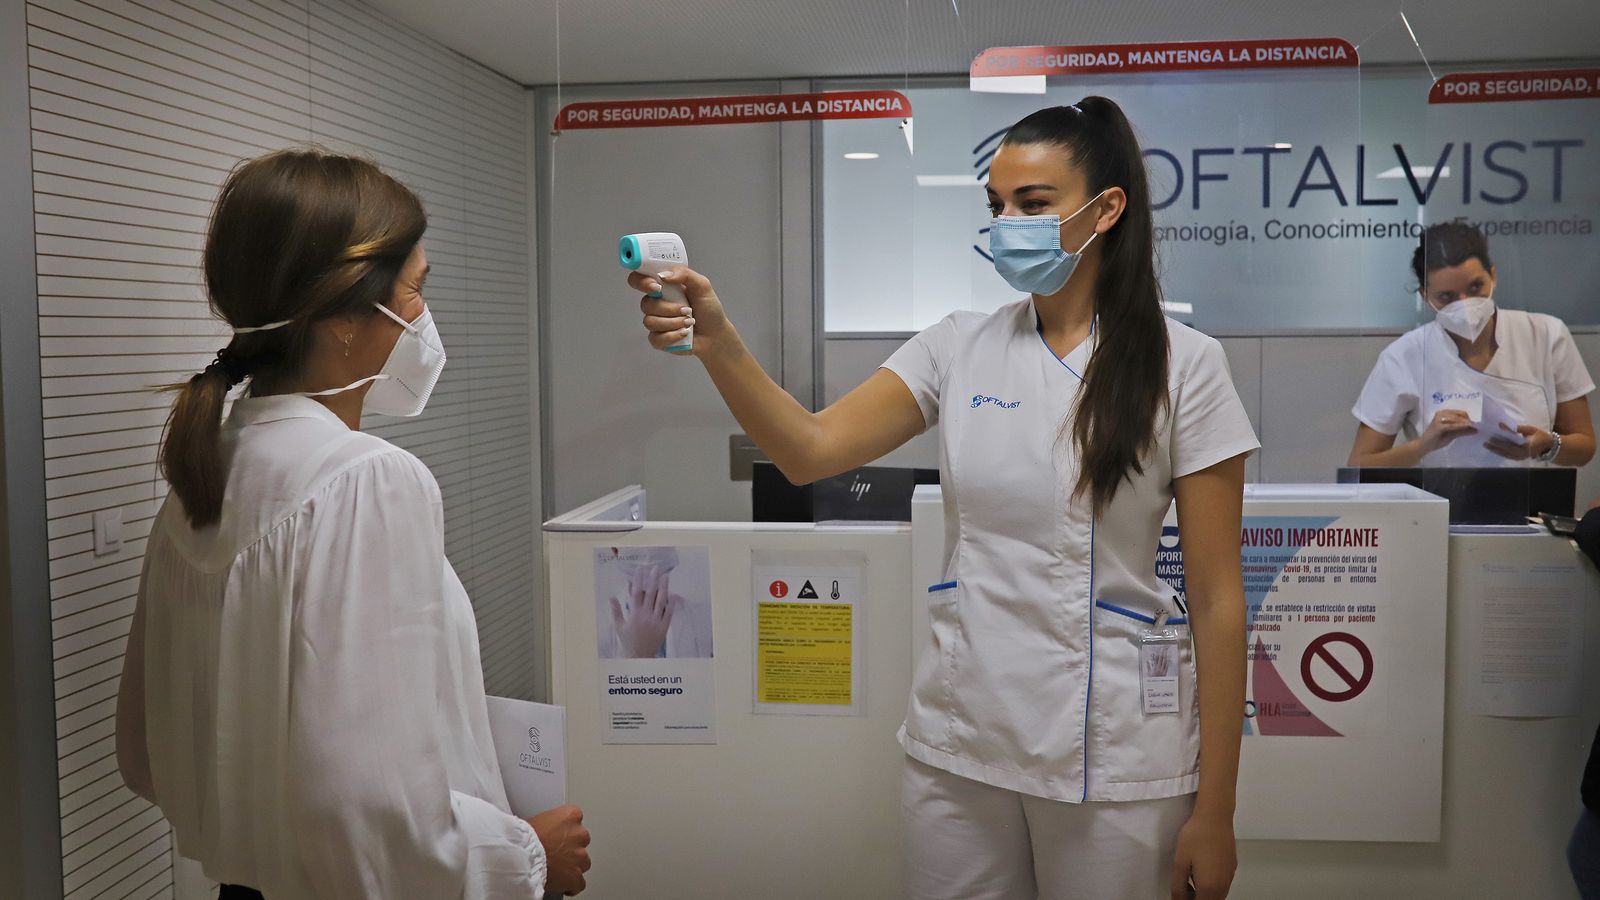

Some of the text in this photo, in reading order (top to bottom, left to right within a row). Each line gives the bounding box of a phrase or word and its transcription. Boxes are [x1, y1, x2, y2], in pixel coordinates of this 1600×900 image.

[1023, 52, 1124, 69] SEGURIDAD,
[1128, 49, 1224, 65] MANTENGA
[1228, 48, 1251, 62] LA
[1255, 46, 1347, 61] DISTANCIA
[1444, 77, 1592, 96] POR SEGURIDAD,
[568, 97, 903, 122] POR SEGURIDAD, MANTENGA LA DISTANCIA
[1264, 218, 1425, 240] Conocimiento
[982, 396, 1021, 409] OFTALVIST
[1241, 528, 1379, 547] AVISO IMPORTANTE
[1301, 555, 1306, 563] la
[1307, 555, 1340, 564] prevención
[1341, 555, 1351, 563] del
[1351, 555, 1367, 563] virus
[1367, 555, 1377, 563] del
[1283, 564, 1312, 574] Covid-19,
[1323, 565, 1345, 574] preciso
[1348, 565, 1368, 573] limitar
[1371, 565, 1377, 573] la
[1281, 575, 1290, 583] de
[1298, 576, 1325, 584] personas
[1350, 575, 1377, 583] entornos
[1243, 584, 1278, 592] ospitalarios
[1275, 604, 1303, 612] establece
[1305, 604, 1311, 612] la
[1313, 604, 1345, 612] restricción
[1347, 604, 1355, 612] de
[1356, 604, 1376, 612] visitas
[1304, 615, 1330, 623] persona
[1334, 615, 1344, 623] por
[1348, 614, 1376, 623] paciente
[1247, 623, 1281, 632] spitalizado
[608, 675, 682, 684] Está usted en un
[608, 687, 683, 696] entorno seguro
[1260, 702, 1281, 717] HLA
